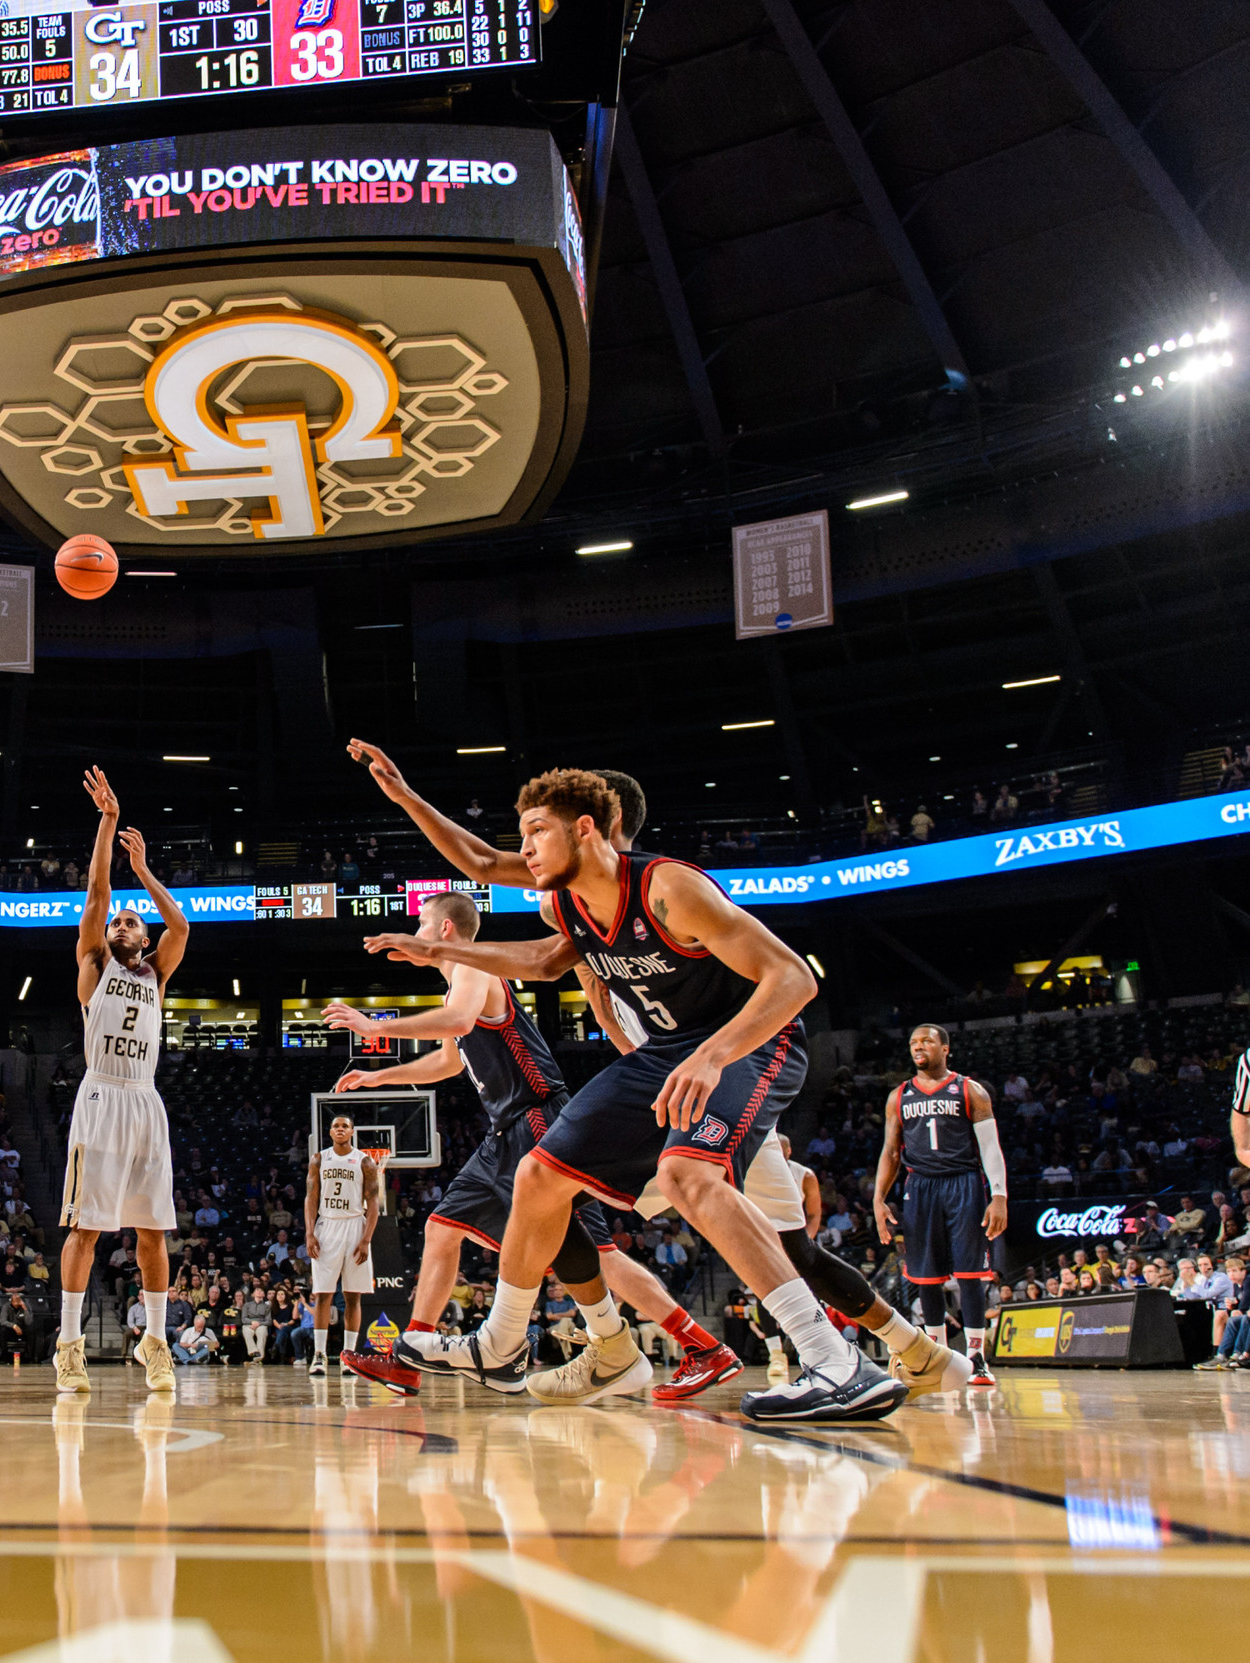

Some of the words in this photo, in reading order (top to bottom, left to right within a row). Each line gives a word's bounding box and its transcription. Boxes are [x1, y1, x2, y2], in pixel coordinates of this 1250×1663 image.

[199, 0, 230, 15] POSS
[376, 5, 388, 23] 7
[408, 3, 425, 19] 3P
[433, 0, 462, 16] 36.4
[474, 0, 484, 14] 5
[1, 20, 28, 37] 35.5
[37, 15, 62, 27] TEAM
[471, 15, 489, 31] 22
[498, 13, 506, 28] 1
[515, 10, 531, 26] 11
[36, 27, 66, 39] FOULS
[170, 25, 201, 47] 1ST
[234, 18, 258, 42] 30
[364, 31, 400, 48] BONUS
[408, 28, 426, 44] FT
[427, 24, 464, 42] 100.0
[472, 31, 490, 47] 30
[497, 29, 507, 44] 0
[519, 27, 529, 43] 0
[1, 44, 28, 60] 50.0
[45, 39, 56, 57] 5
[290, 29, 344, 81] 33
[472, 48, 490, 64] 33
[499, 46, 507, 61] 1
[520, 44, 529, 59] 3
[366, 57, 392, 73] TOL
[392, 55, 402, 71] 4
[410, 51, 439, 69] REB
[448, 48, 465, 65] 19
[2, 69, 29, 85] 77.8
[34, 64, 70, 82] BONUS
[90, 49, 142, 101] 34
[196, 50, 259, 90] 1:16
[13, 93, 29, 108] 21
[35, 91, 58, 106] TOL
[60, 89, 68, 104] 4
[124, 170, 193, 199] YOU
[201, 161, 304, 192] DON'T
[311, 158, 419, 183] KNOW
[427, 159, 518, 185] ZERO
[124, 195, 180, 220] 'TIL
[187, 183, 309, 214] YOU'VE
[315, 181, 414, 205] TRIED
[787, 569, 812, 584] 2012
[788, 582, 813, 598] 2014
[994, 821, 1125, 866] ZAXBY'S
[837, 859, 909, 885] WINGS
[257, 887, 281, 896] FOULS
[297, 886, 309, 895] GA
[309, 885, 328, 895] TECH
[359, 885, 381, 894] POSS
[407, 881, 447, 892] DUQUESNE
[452, 881, 477, 890] FOULS
[190, 894, 255, 913] WINGS
[302, 896, 323, 916] 34
[350, 898, 381, 917] 1:16
[390, 901, 404, 911] 1ST
[630, 985, 678, 1031] 5
[122, 1006, 139, 1032] 2
[104, 1035, 149, 1061] TECH
[902, 1100, 961, 1120] DUQUESNE
[926, 1118, 938, 1150] 1
[322, 1168, 355, 1181] GEORGIA
[333, 1182, 342, 1195] 3
[324, 1197, 350, 1210] TECH
[1036, 1204, 1126, 1238] Coca-Cola
[376, 1277, 404, 1288] PNC
